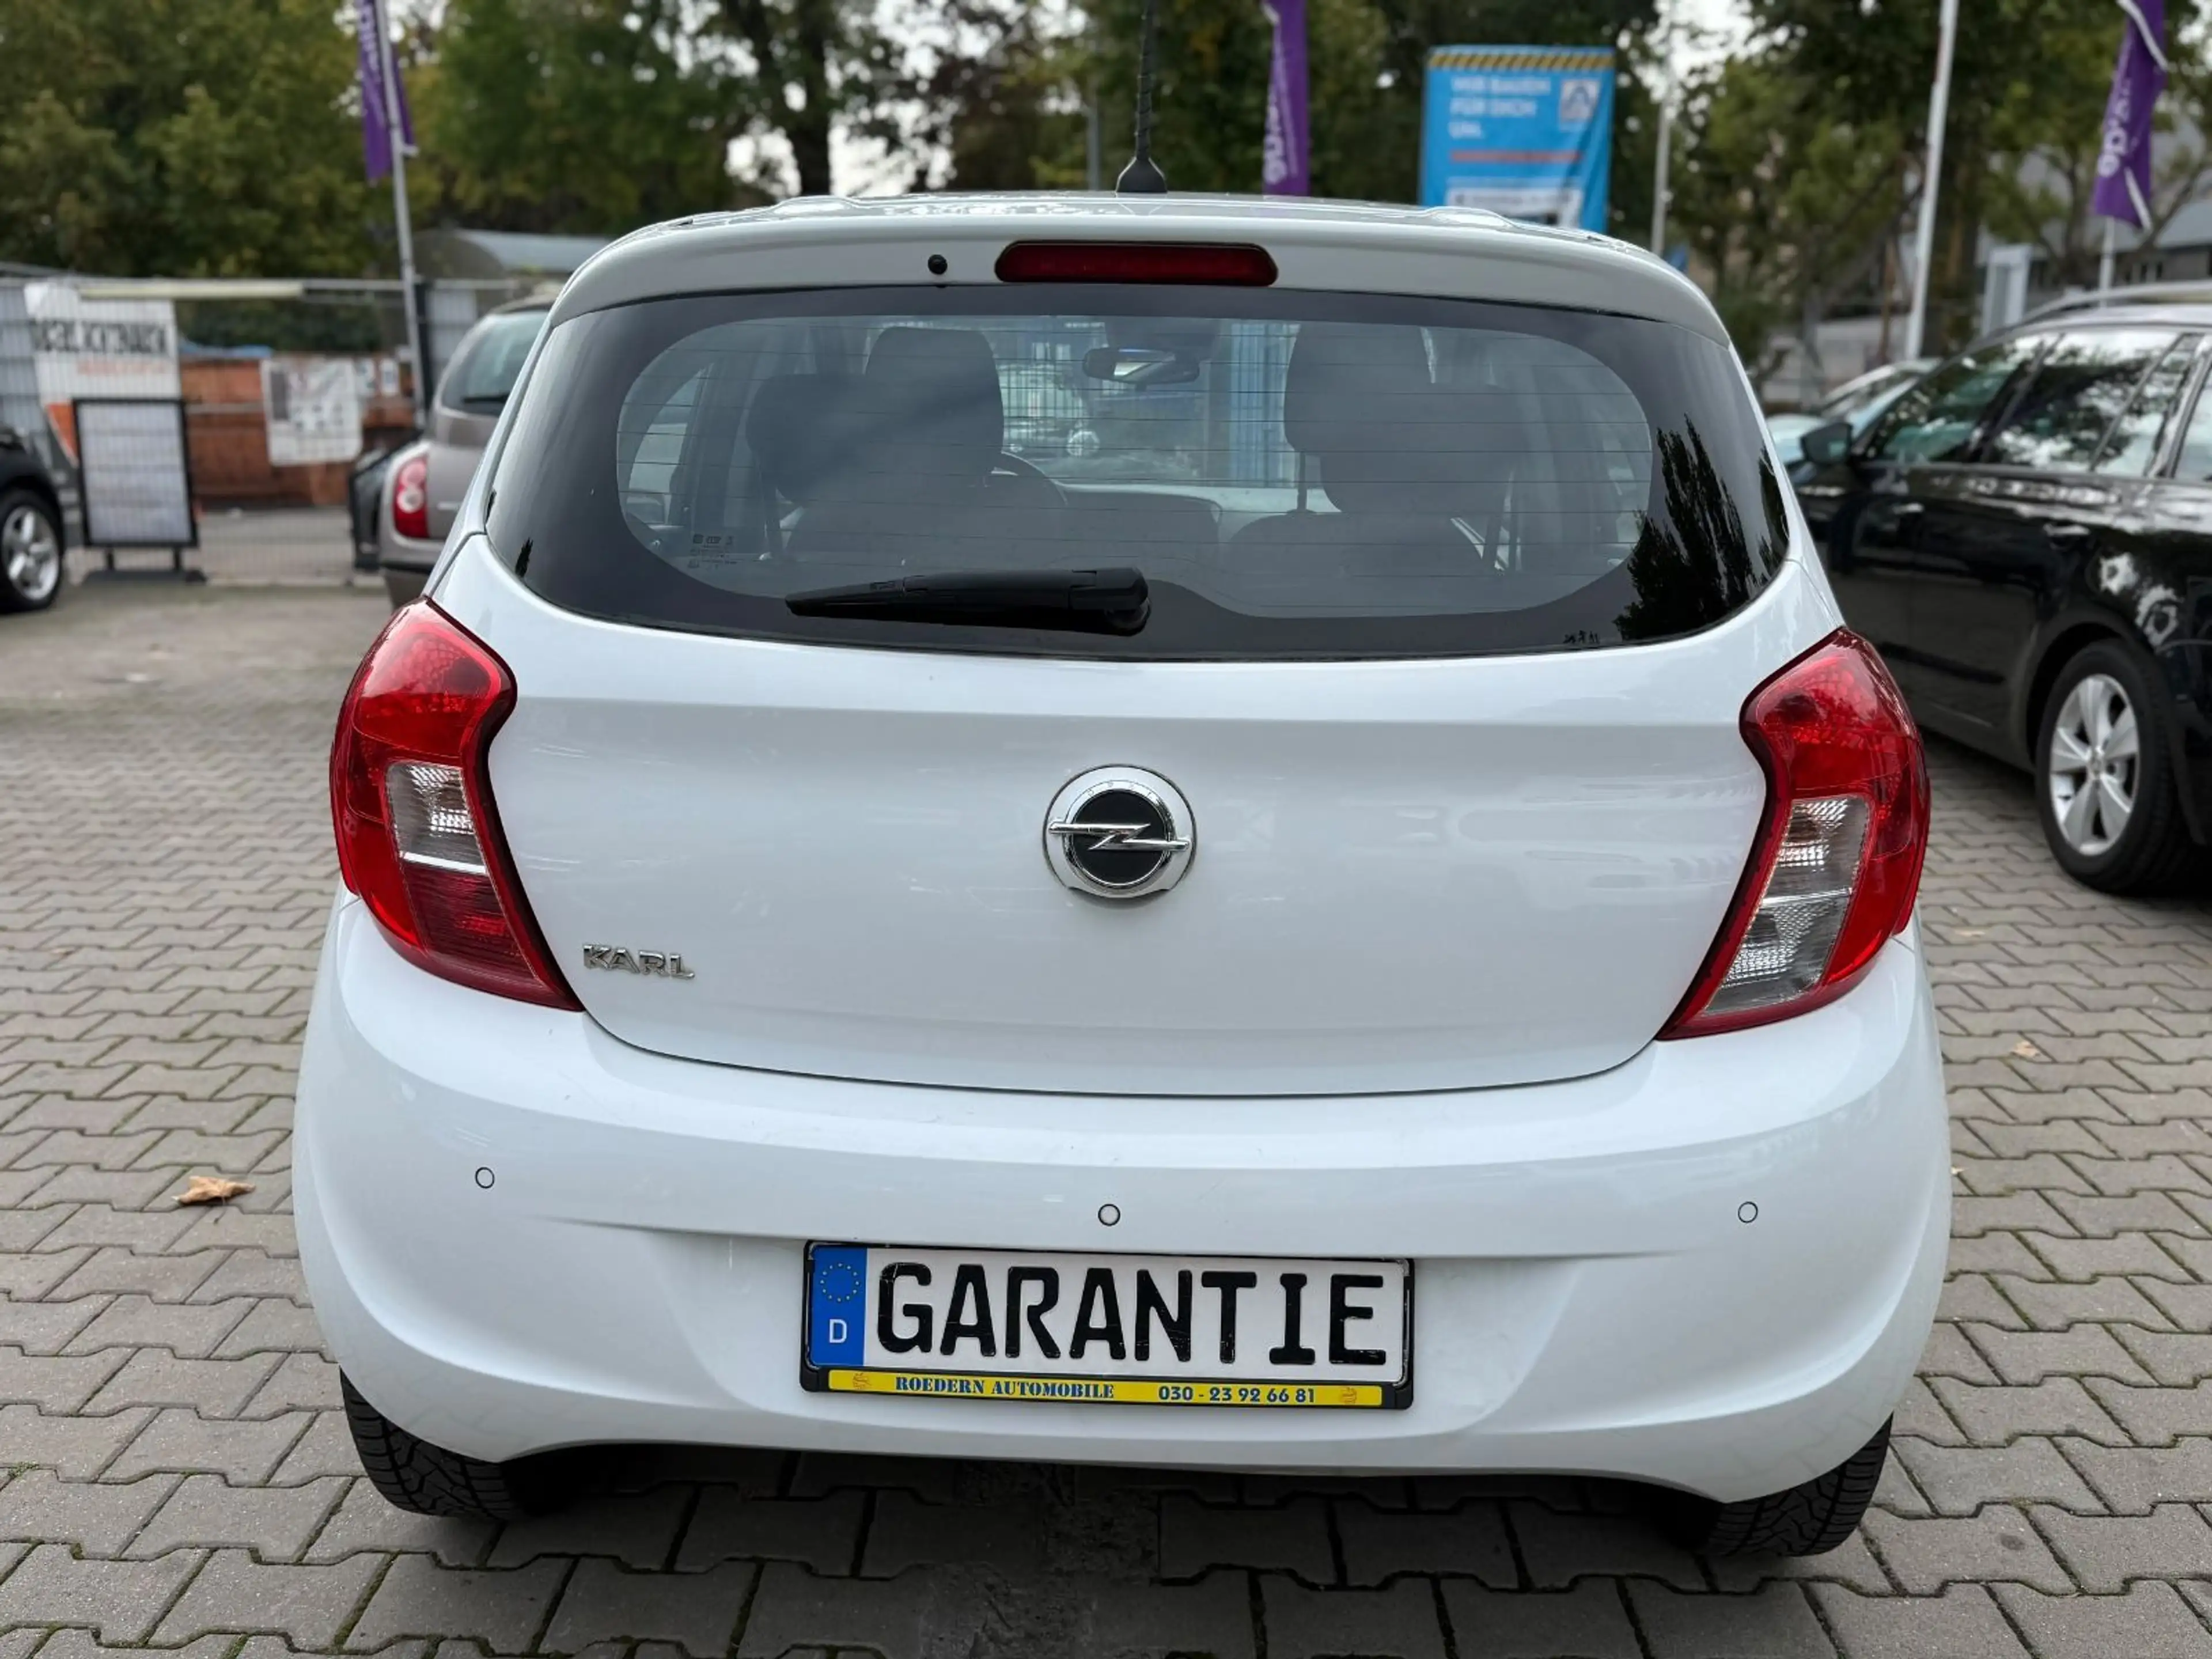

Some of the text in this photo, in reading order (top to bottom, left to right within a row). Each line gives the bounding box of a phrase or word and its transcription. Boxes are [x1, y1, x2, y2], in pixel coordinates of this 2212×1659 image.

[583, 944, 695, 980] KARL
[877, 1262, 1387, 1366] GARANTIE
[830, 1319, 847, 1343] D
[896, 1376, 984, 1394] ROEDERN
[991, 1380, 1114, 1399] AUTOMOBILE
[1158, 1385, 1194, 1401] 030
[1209, 1387, 1232, 1402] 23
[1238, 1388, 1261, 1403] 92
[1266, 1388, 1289, 1403] 66
[1295, 1388, 1315, 1403] 81
